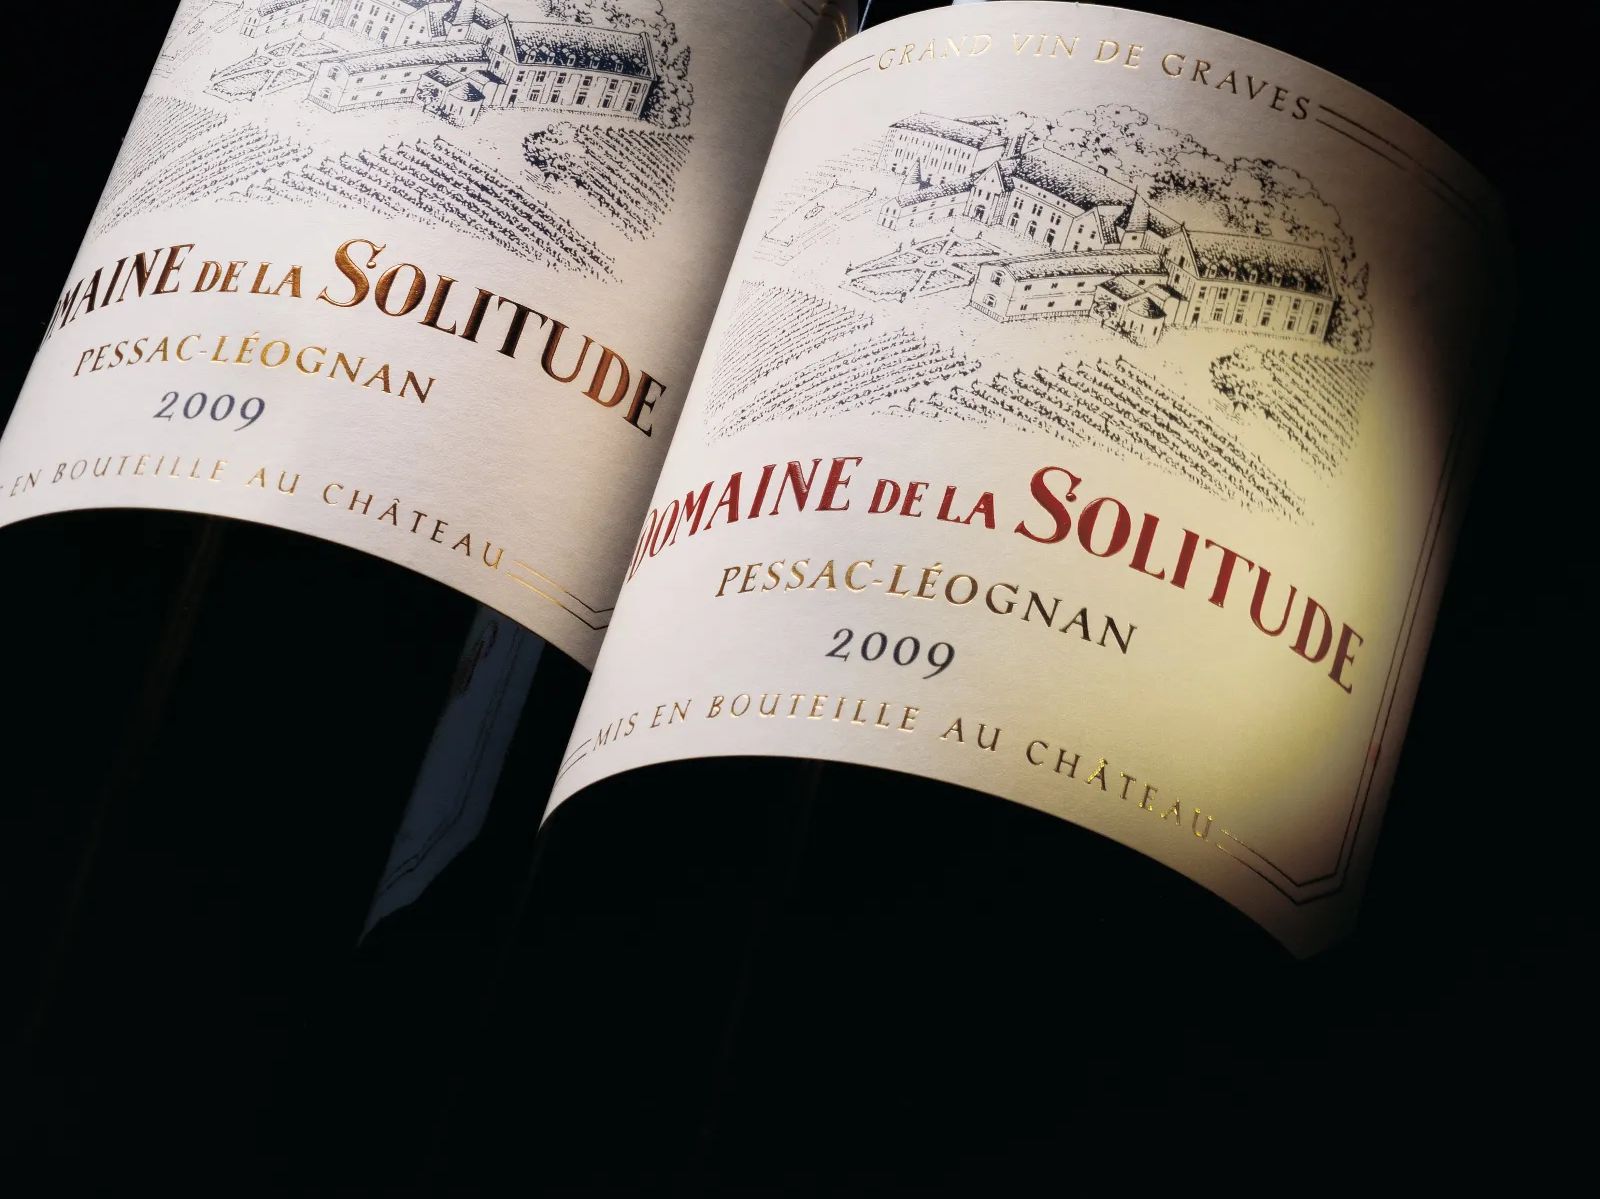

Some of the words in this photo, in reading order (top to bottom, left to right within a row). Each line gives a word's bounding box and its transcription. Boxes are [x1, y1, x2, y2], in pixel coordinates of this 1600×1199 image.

[878, 33, 993, 71] GRAND
[1011, 33, 1081, 60] VIN
[1094, 39, 1145, 68] DE
[1161, 53, 1312, 121] GRAVES
[73, 331, 436, 404] PESSAC-LÉOGNAN
[190, 260, 249, 293] DE
[248, 261, 303, 299] LA
[316, 238, 667, 437] SOLITUDE
[152, 391, 266, 432] 2009
[9, 468, 42, 497] EN
[52, 454, 228, 484] BOUTEILLE
[246, 467, 301, 496] AU
[322, 482, 506, 570] CHÂTEAU
[626, 456, 863, 584] DOMAINE
[867, 478, 930, 518] DE
[936, 485, 996, 530] LA
[1014, 466, 1364, 694] SOLITUDE
[715, 559, 1137, 655] PESSAC-LÉOGNAN
[825, 627, 956, 680] 2009
[592, 712, 639, 752] MIS
[649, 699, 692, 730] EN
[706, 693, 920, 733] BOUTEILLE
[939, 717, 1002, 752] AU
[1026, 740, 1213, 842] CHÂTEAU
